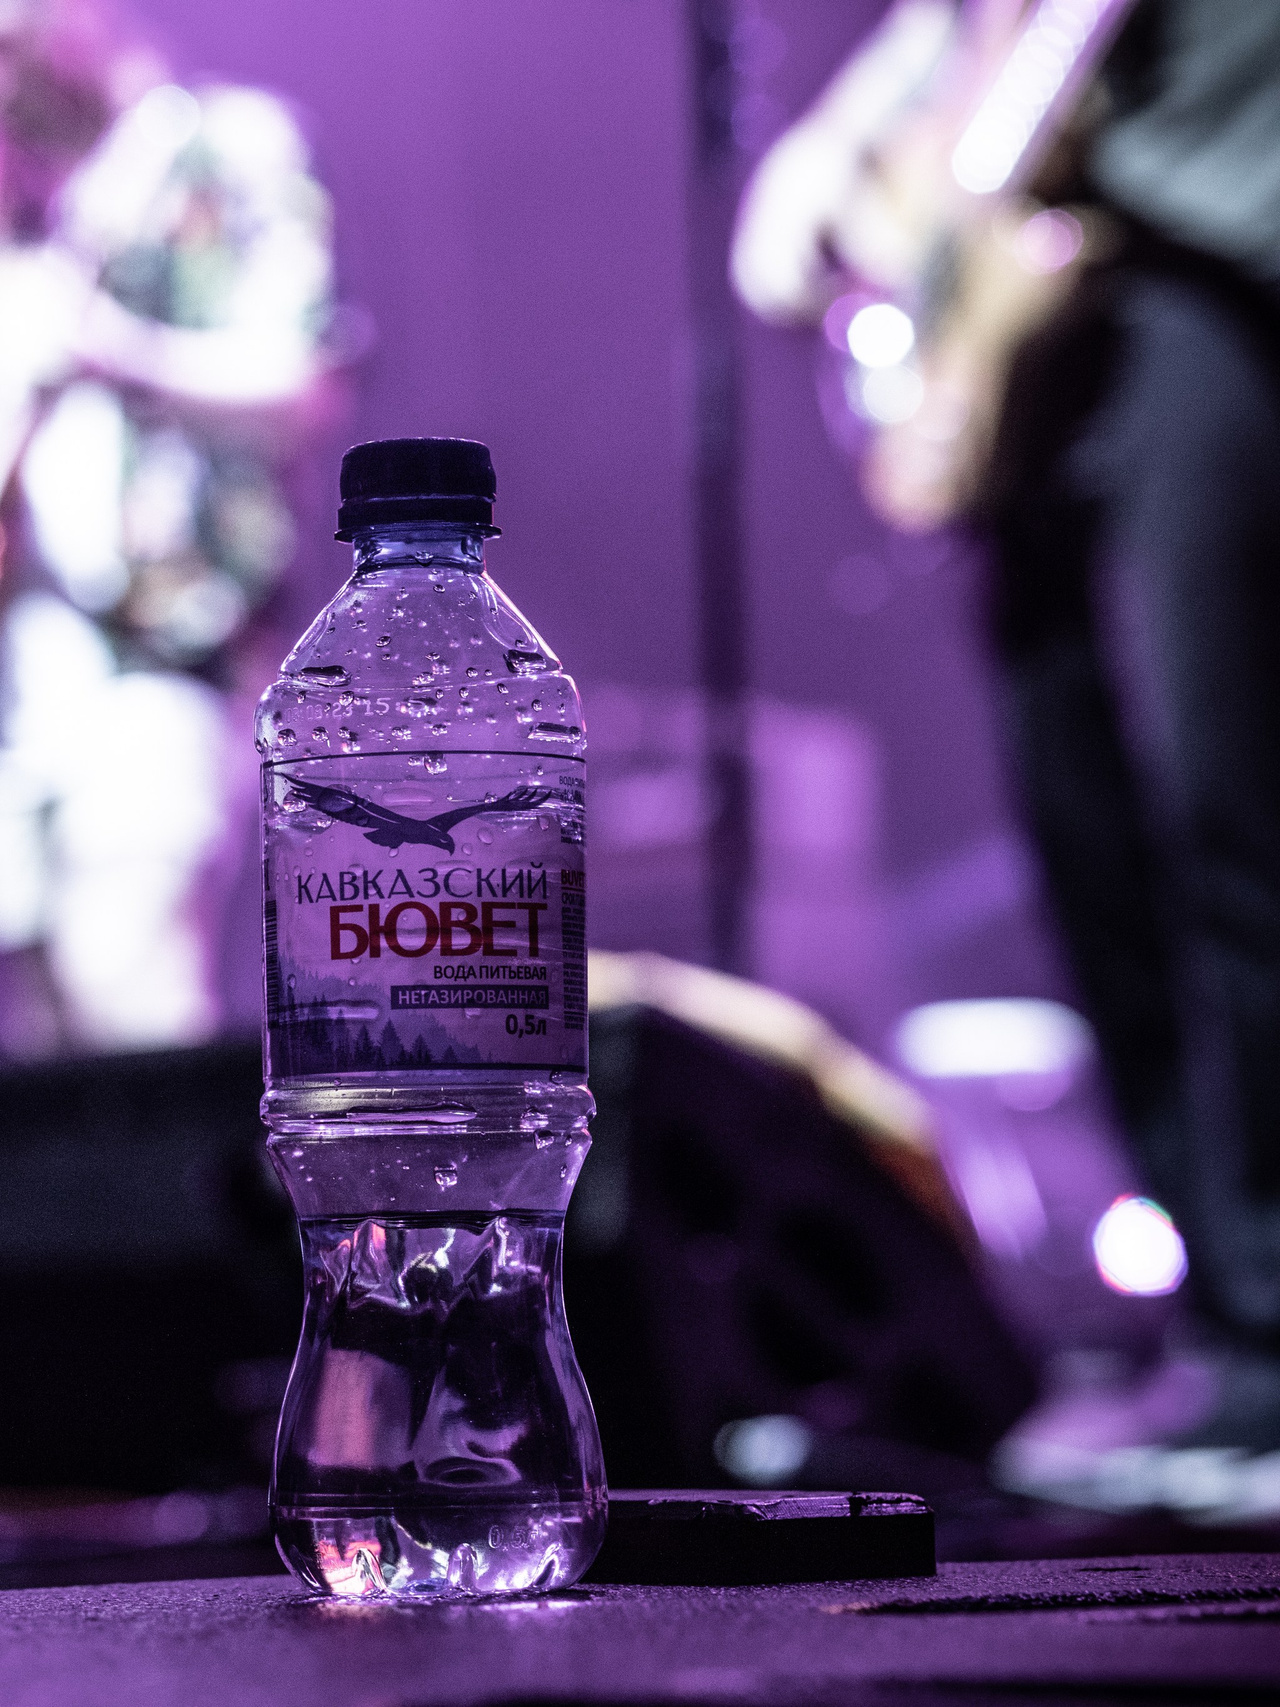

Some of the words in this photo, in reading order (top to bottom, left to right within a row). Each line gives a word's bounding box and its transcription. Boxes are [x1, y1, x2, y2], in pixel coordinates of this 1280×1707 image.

[297, 862, 548, 904] КАВКАЗСКИЙ
[329, 902, 548, 960] БЮВЕТ
[433, 965, 476, 981] ВОДА
[479, 965, 547, 980] ПИТЬЕВАЯ
[398, 990, 547, 1006] НЕГАЗИРОВАННАЯ
[505, 1014, 547, 1039] 0,5л
